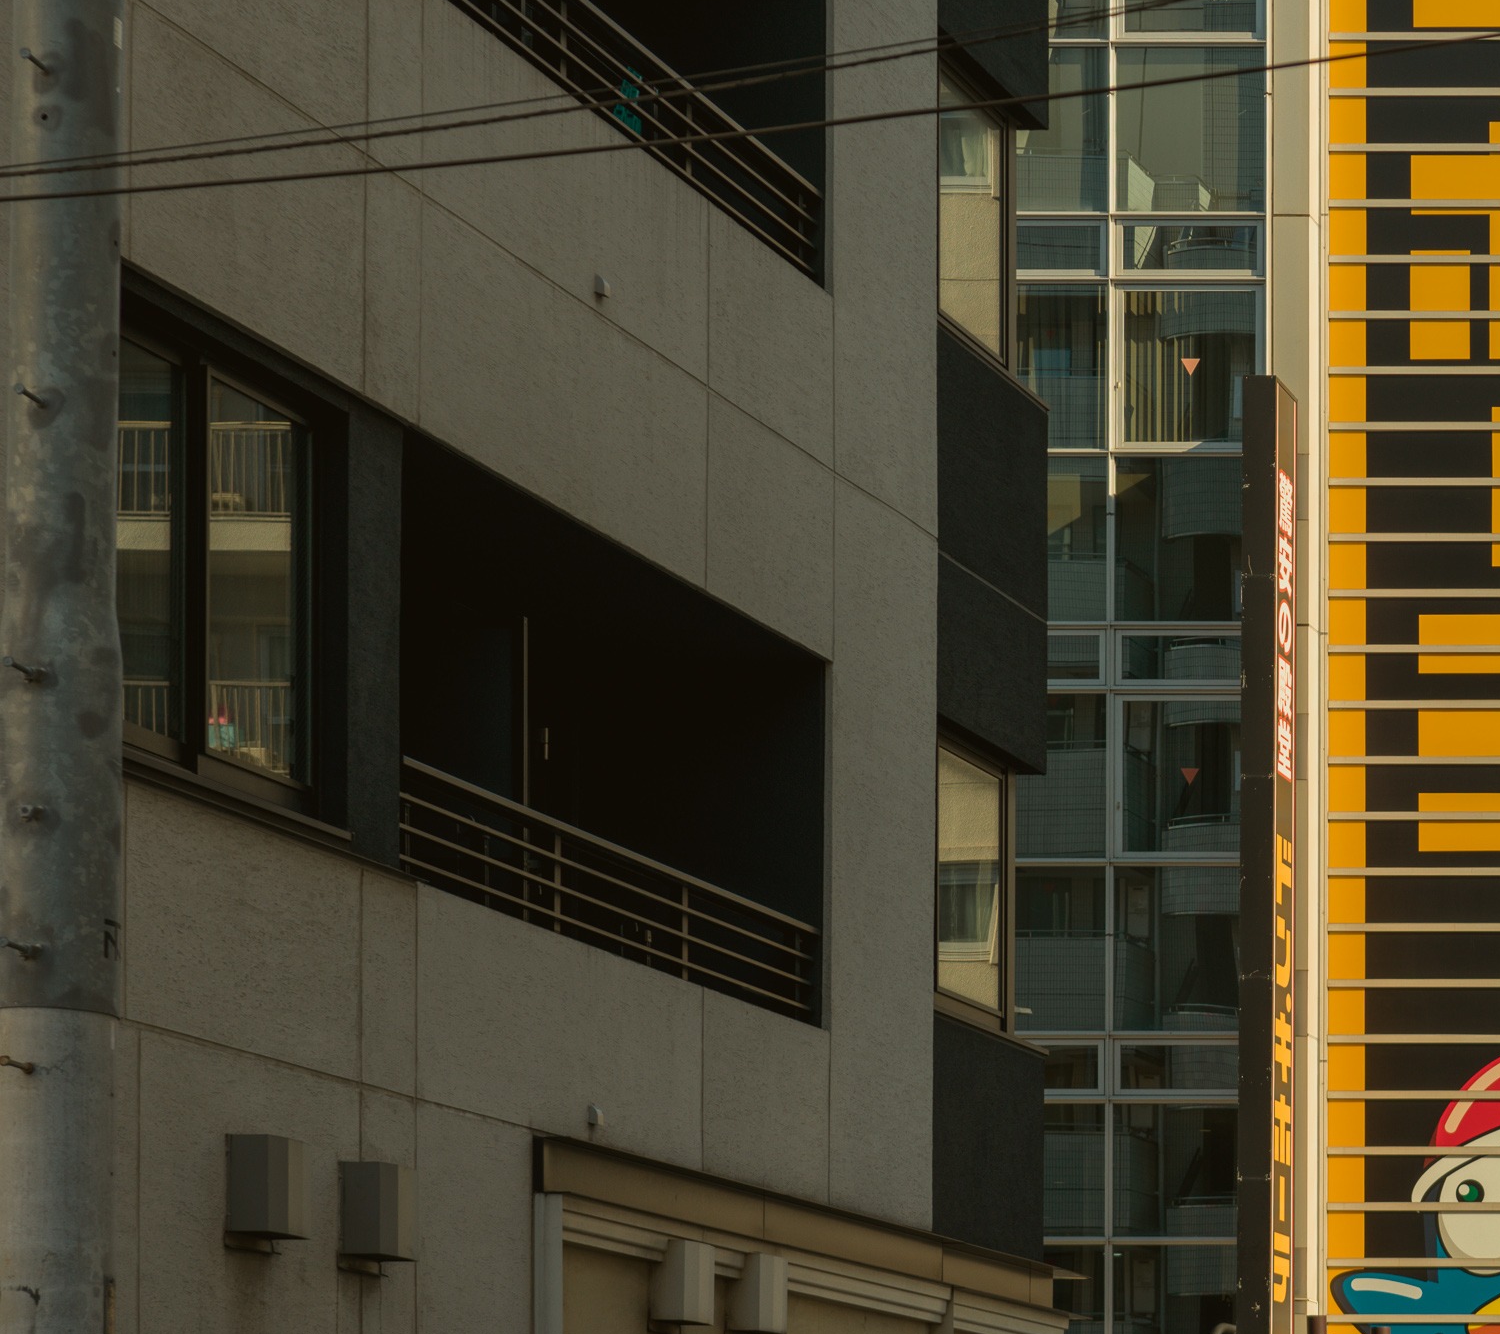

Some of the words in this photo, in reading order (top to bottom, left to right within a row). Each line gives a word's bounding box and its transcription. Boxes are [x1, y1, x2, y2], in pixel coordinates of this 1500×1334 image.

[1274, 833, 1293, 1304] ドン・キホーテ
